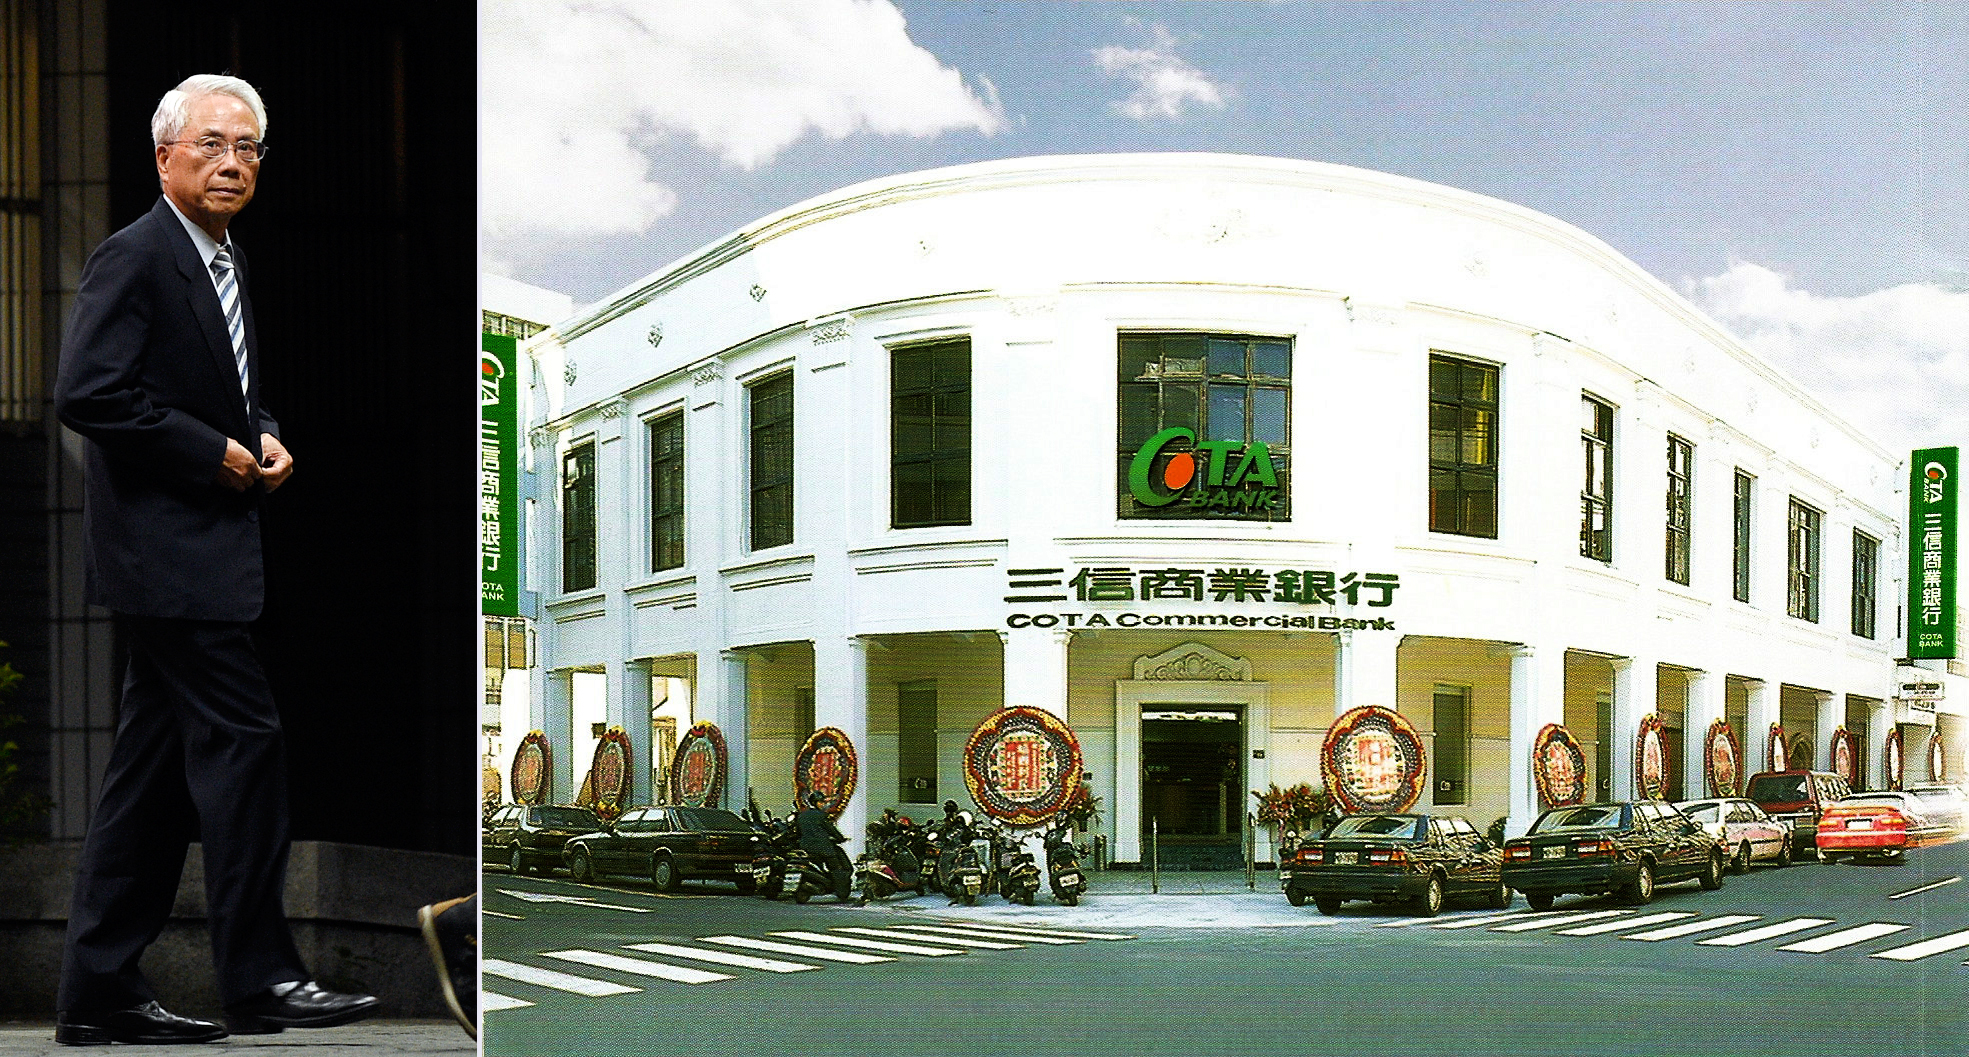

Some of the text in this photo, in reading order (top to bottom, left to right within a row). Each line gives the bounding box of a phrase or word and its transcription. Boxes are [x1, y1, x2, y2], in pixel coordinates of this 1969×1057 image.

[1129, 427, 1278, 507] COTA
[1924, 461, 1948, 503] COTA
[1190, 490, 1277, 507] BANK
[1922, 513, 1942, 625] 三信商業銀行
[482, 582, 504, 592] OTA
[482, 591, 505, 601] ANK
[1004, 567, 1400, 607] 三信商業銀行
[1007, 613, 1396, 631] COTA Commercial Bank
[1919, 640, 1944, 648] BANK
